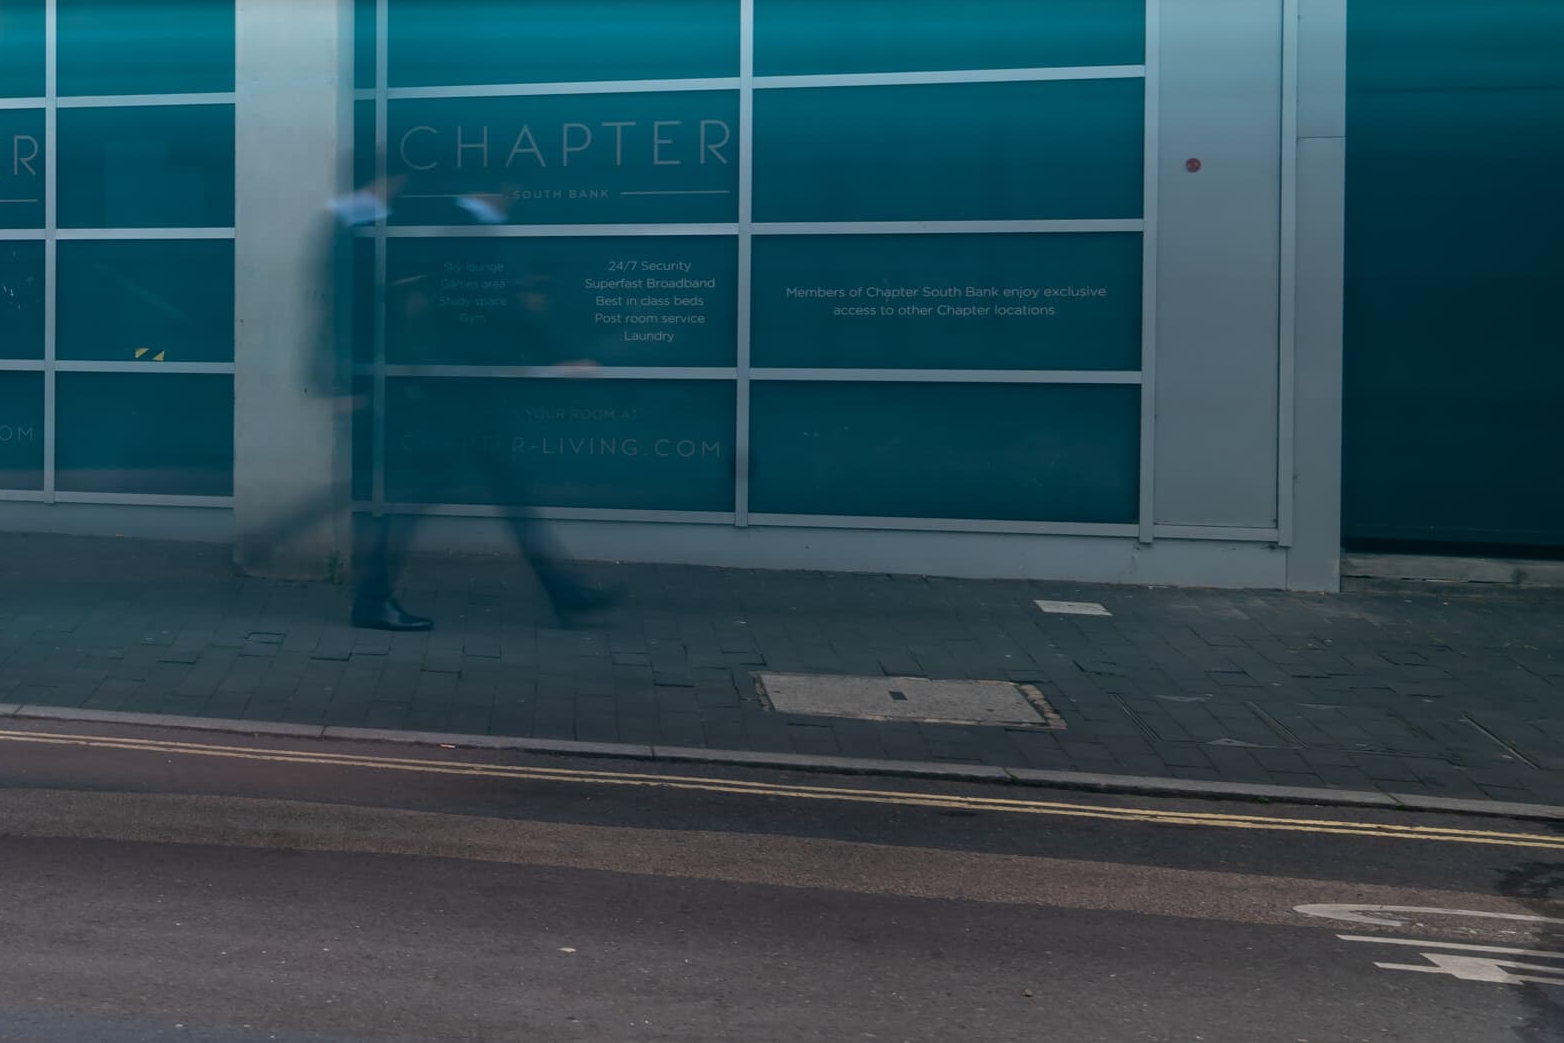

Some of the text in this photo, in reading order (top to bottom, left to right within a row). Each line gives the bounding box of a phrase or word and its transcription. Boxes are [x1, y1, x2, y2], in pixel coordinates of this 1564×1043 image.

[399, 119, 731, 170] CHAPTER
[513, 188, 610, 200] SOUTH BANK
[608, 260, 692, 274] 24/7 Security
[584, 277, 716, 290] Superfast Broadband
[786, 285, 1107, 301] Members of Chapter South Bank enjoy exclusive
[595, 295, 705, 307] Best in class beds
[594, 312, 706, 324] Post room service
[832, 303, 1056, 319] access to other Chapter locations
[623, 329, 675, 343] Laundry
